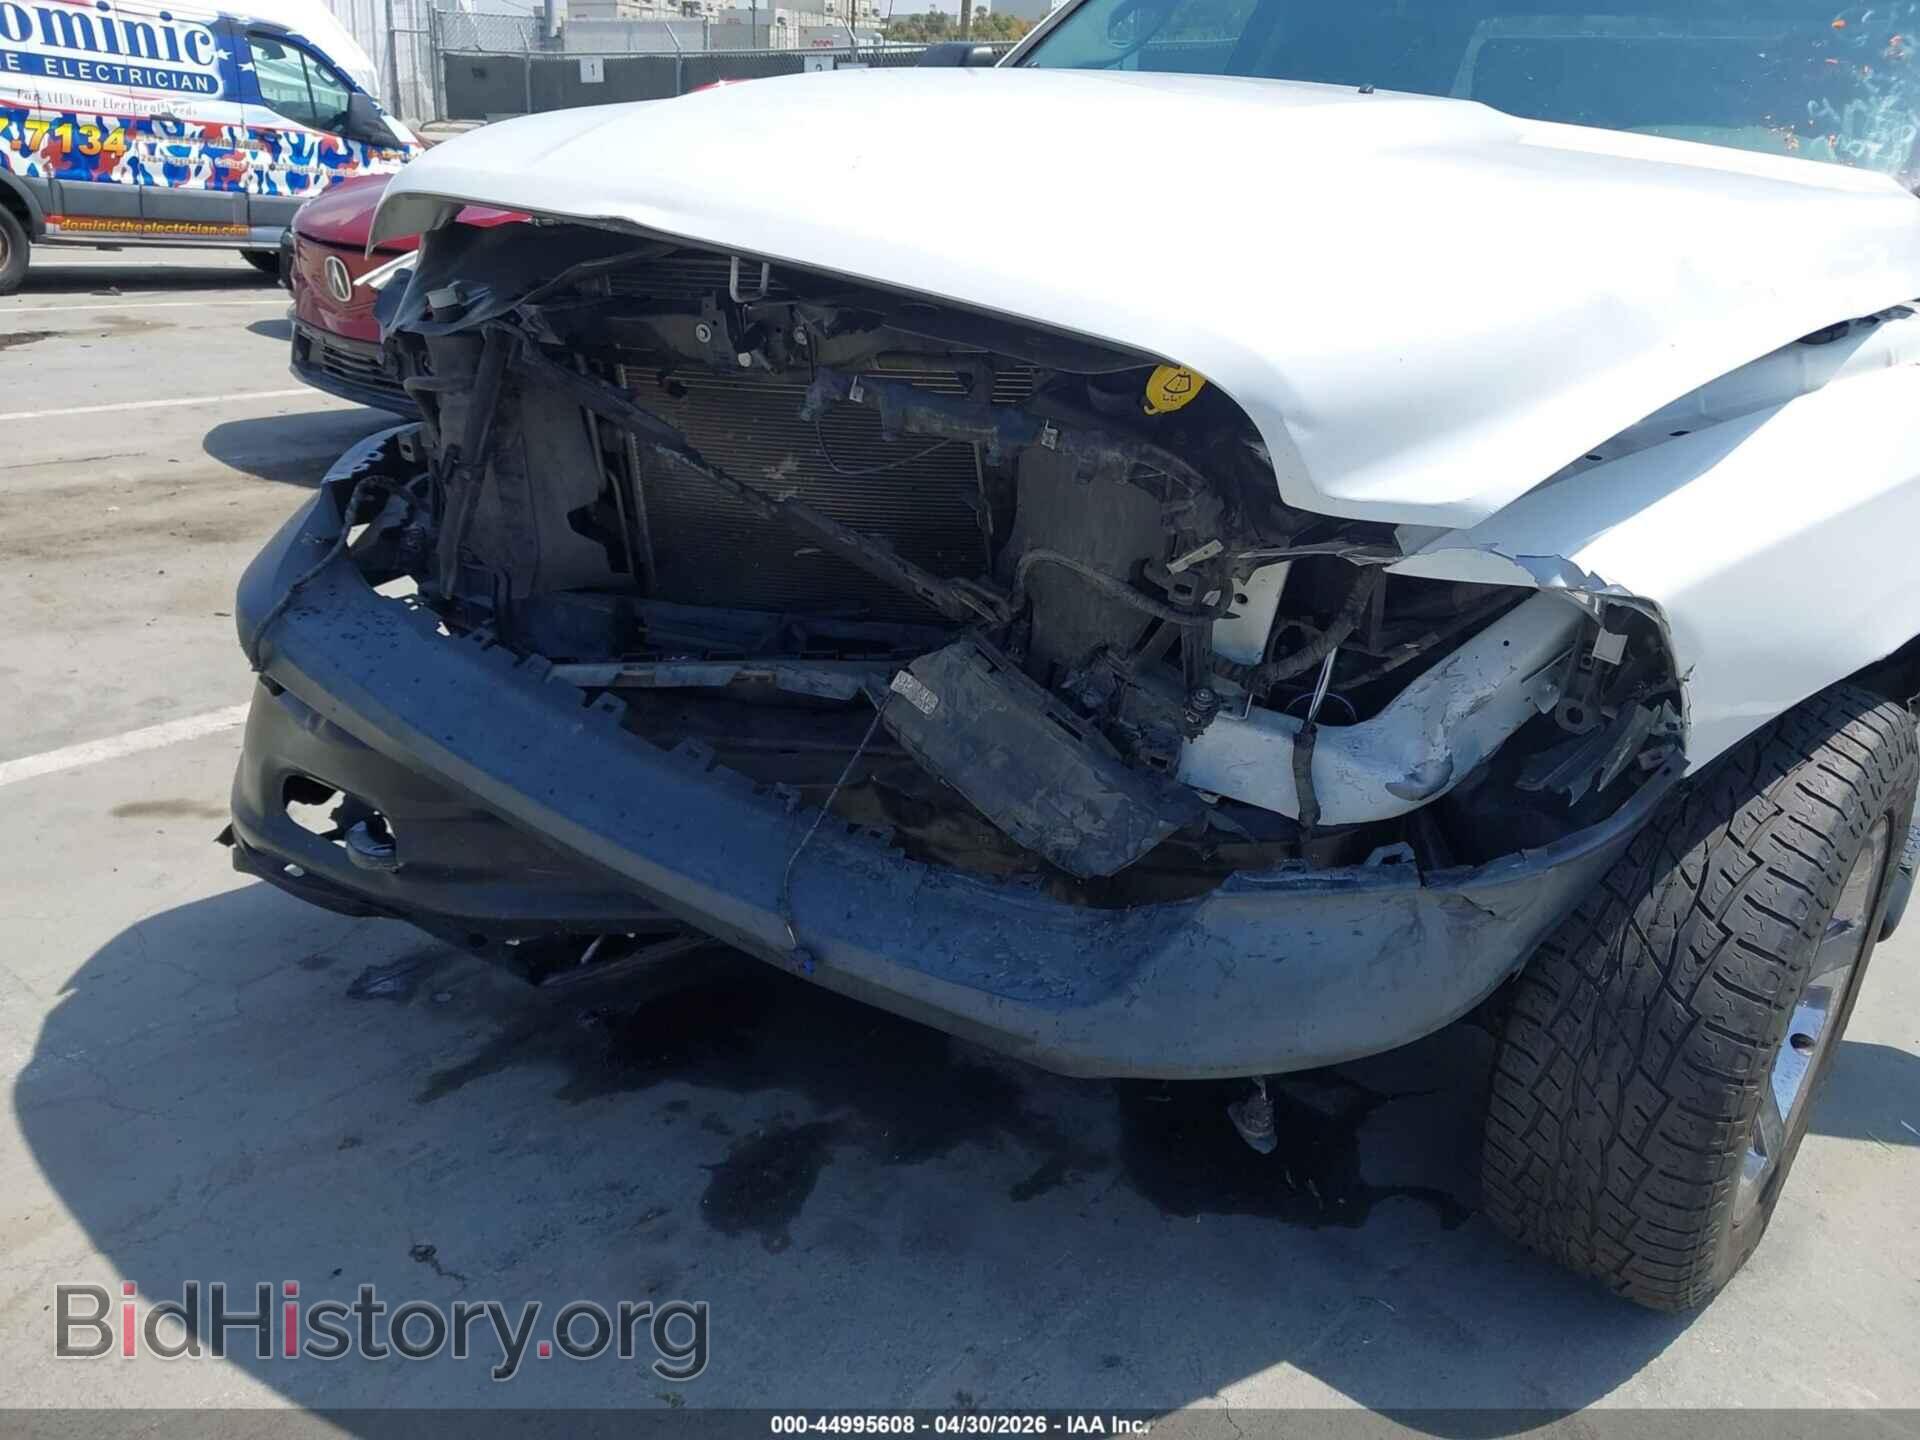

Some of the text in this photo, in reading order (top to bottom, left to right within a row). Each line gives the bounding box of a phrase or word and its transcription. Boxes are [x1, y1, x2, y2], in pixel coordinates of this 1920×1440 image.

[0, 53, 209, 91] E ELECTRICIAN
[17, 88, 40, 102] For
[47, 91, 64, 105] All
[69, 94, 96, 108] Your
[60, 218, 249, 236] dominictheelectrician.com
